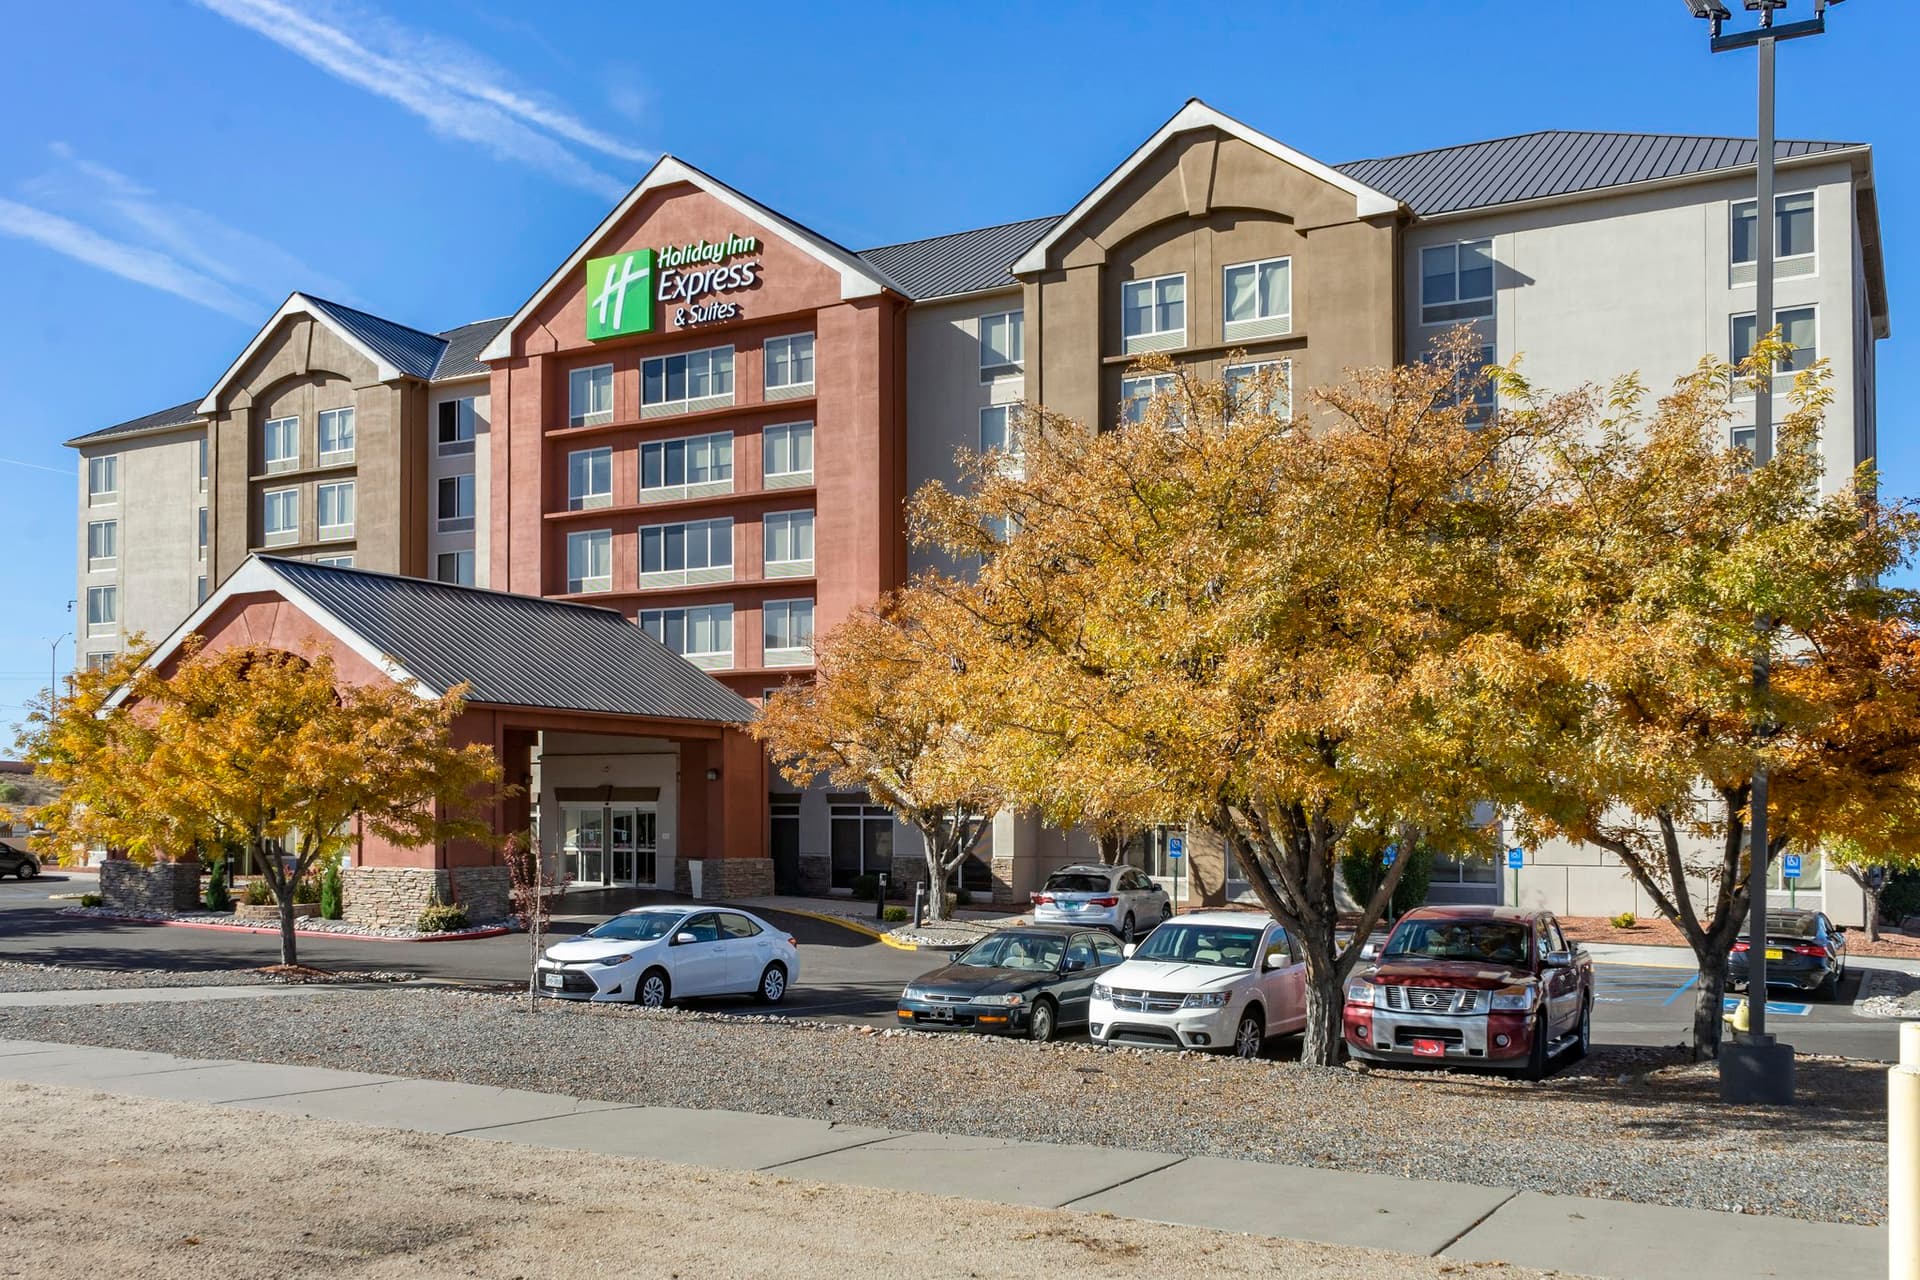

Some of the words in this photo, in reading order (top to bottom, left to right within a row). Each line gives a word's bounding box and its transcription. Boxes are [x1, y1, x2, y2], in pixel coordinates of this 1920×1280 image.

[657, 239, 725, 269] Holiday
[727, 232, 756, 257] Inn
[657, 261, 756, 304] Express
[673, 307, 686, 327] &
[688, 301, 736, 324] Suites
